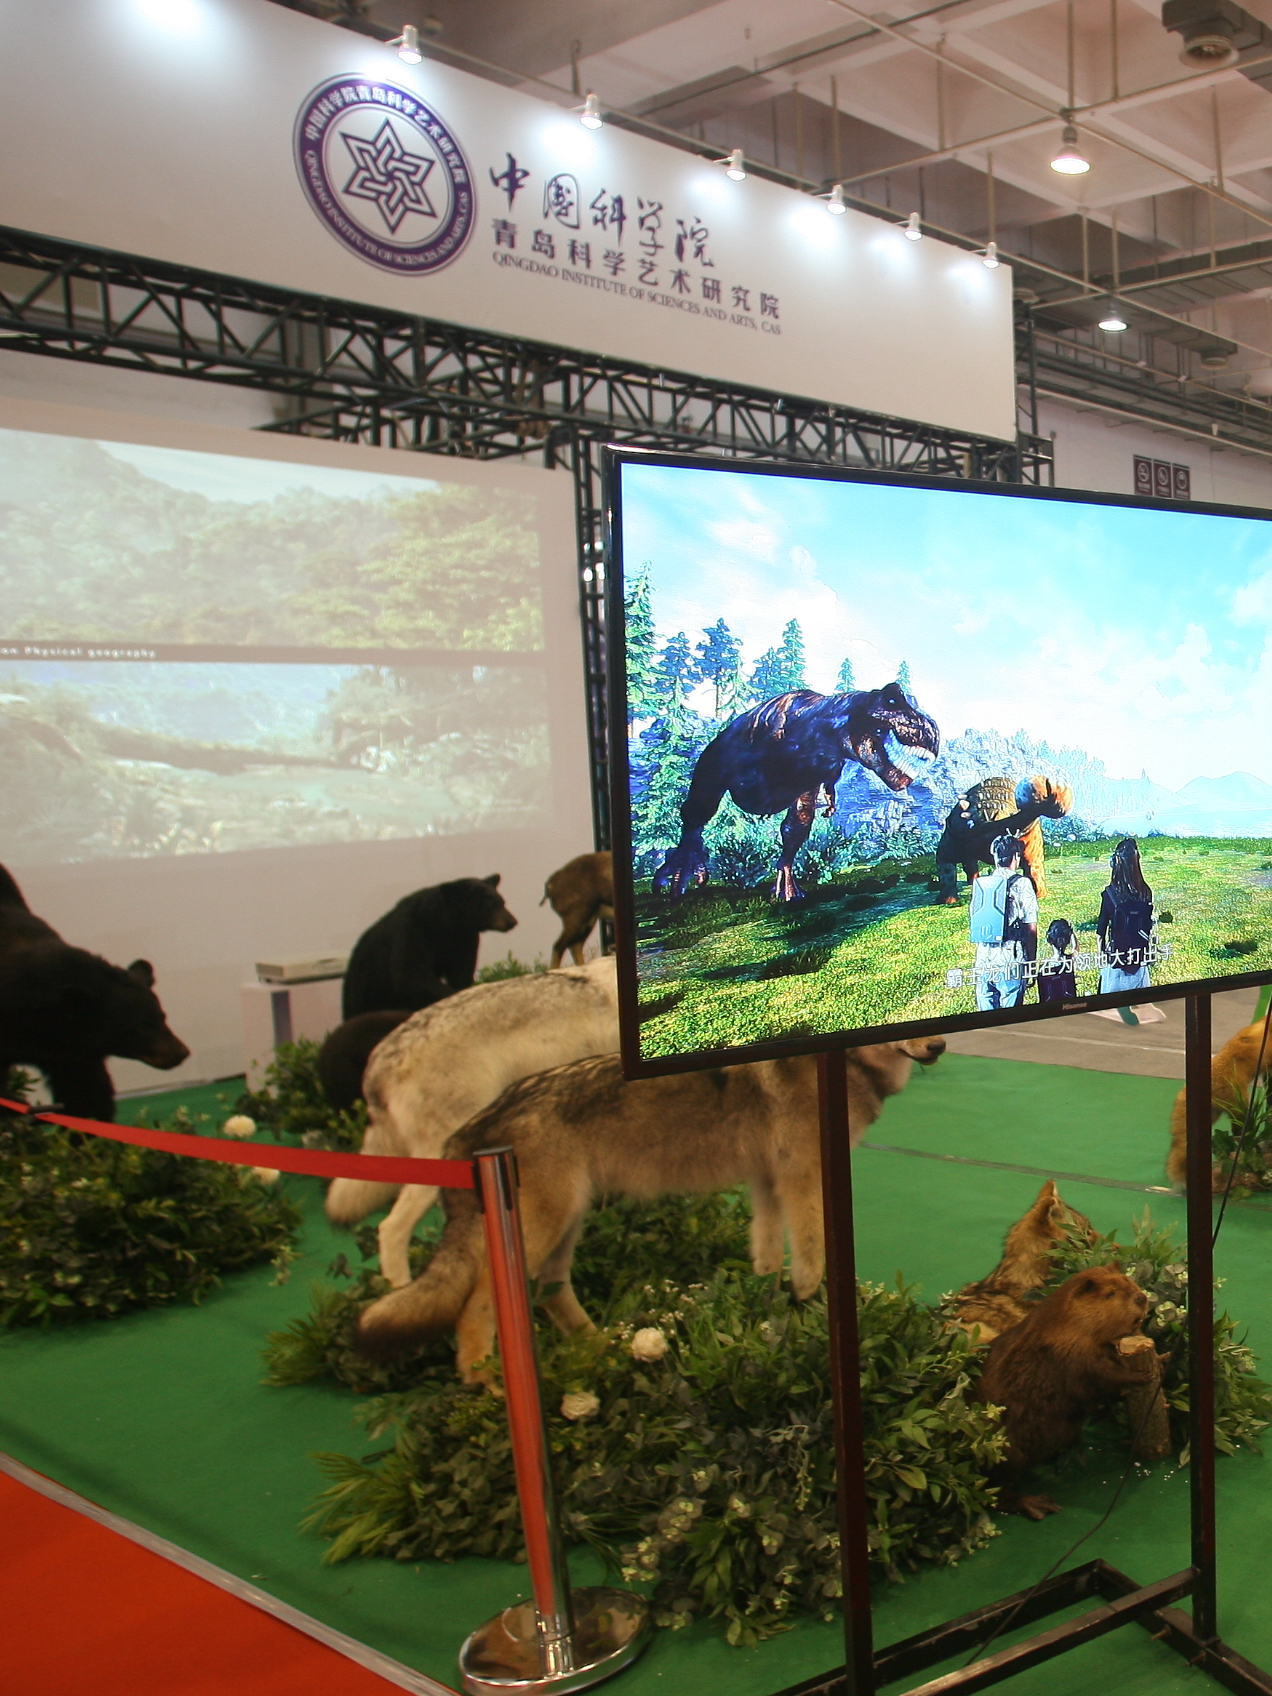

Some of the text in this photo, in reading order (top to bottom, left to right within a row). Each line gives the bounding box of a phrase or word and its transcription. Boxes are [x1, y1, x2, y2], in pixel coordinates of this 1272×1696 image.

[491, 218, 780, 319] 青岛科学艺术研究院
[492, 251, 559, 279] QINGDAO
[561, 269, 628, 296] INSTITUTE
[628, 285, 645, 299] OF
[647, 290, 700, 314] SCIENCES
[703, 306, 727, 320] AND
[761, 321, 781, 335] CAS
[24, 646, 83, 657] Physical
[87, 648, 156, 659] geography
[946, 942, 1174, 989] 霸王龙们正在为领地大打出手
[1062, 1002, 1087, 1011] Hisense
